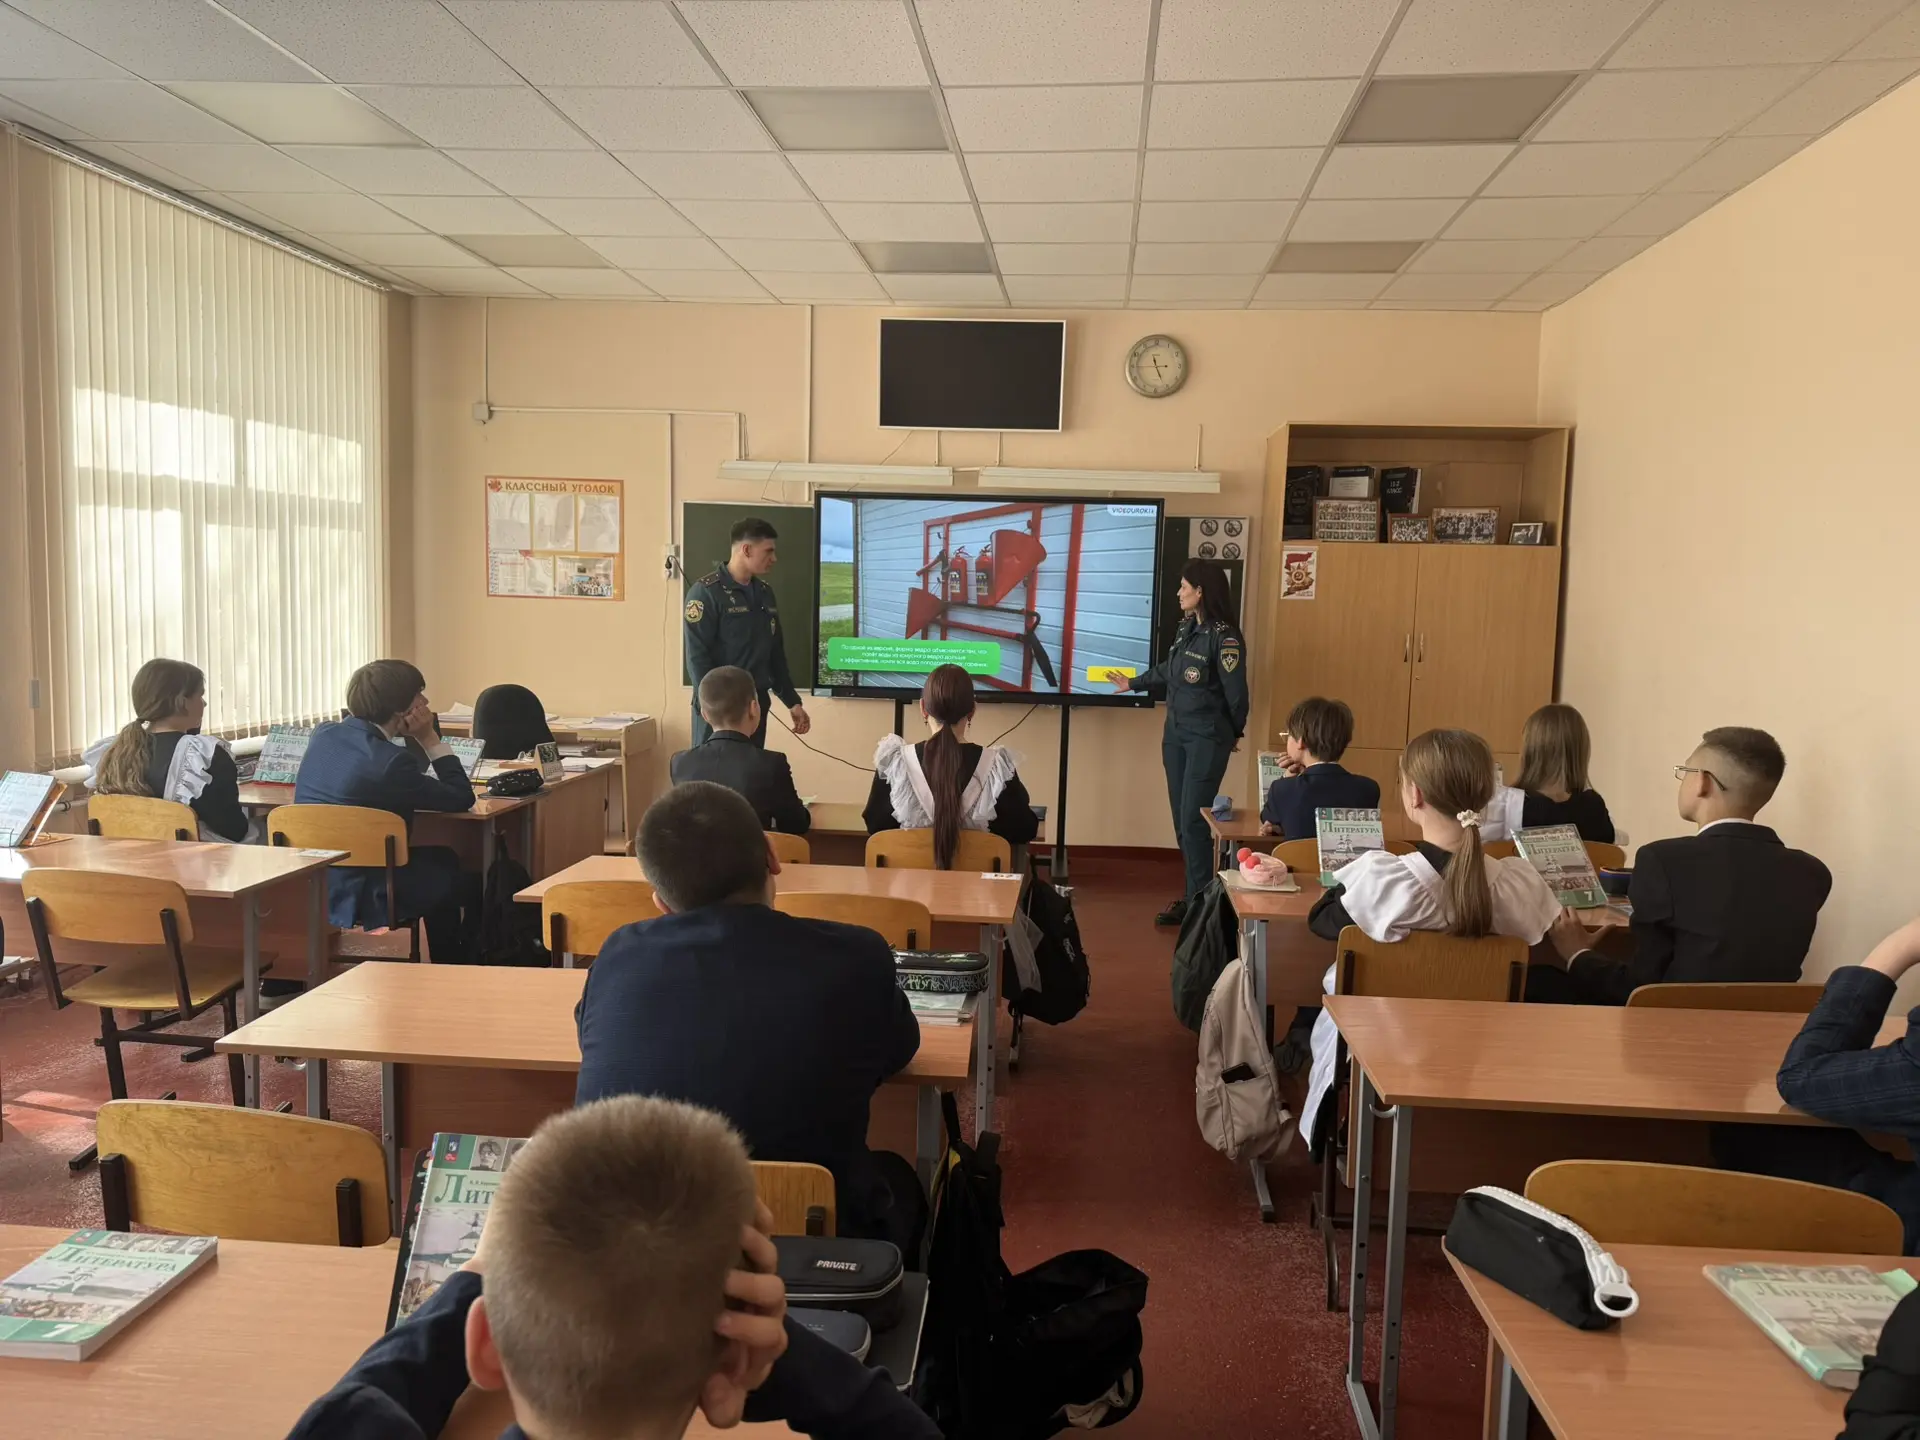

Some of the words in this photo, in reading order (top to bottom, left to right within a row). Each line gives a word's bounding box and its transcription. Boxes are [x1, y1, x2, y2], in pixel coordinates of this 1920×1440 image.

[505, 481, 567, 492] КЛАССНЫЙ
[572, 483, 615, 494] УГОЛОК
[1322, 821, 1381, 834] ЛИТЕРАТУРА
[1584, 890, 1593, 901] 7
[434, 1173, 495, 1204] ЛИТ
[46, 1246, 177, 1273] ЛИТЕРАТУРА
[816, 1259, 858, 1271] PRIVATE
[41, 1323, 79, 1338] 7
